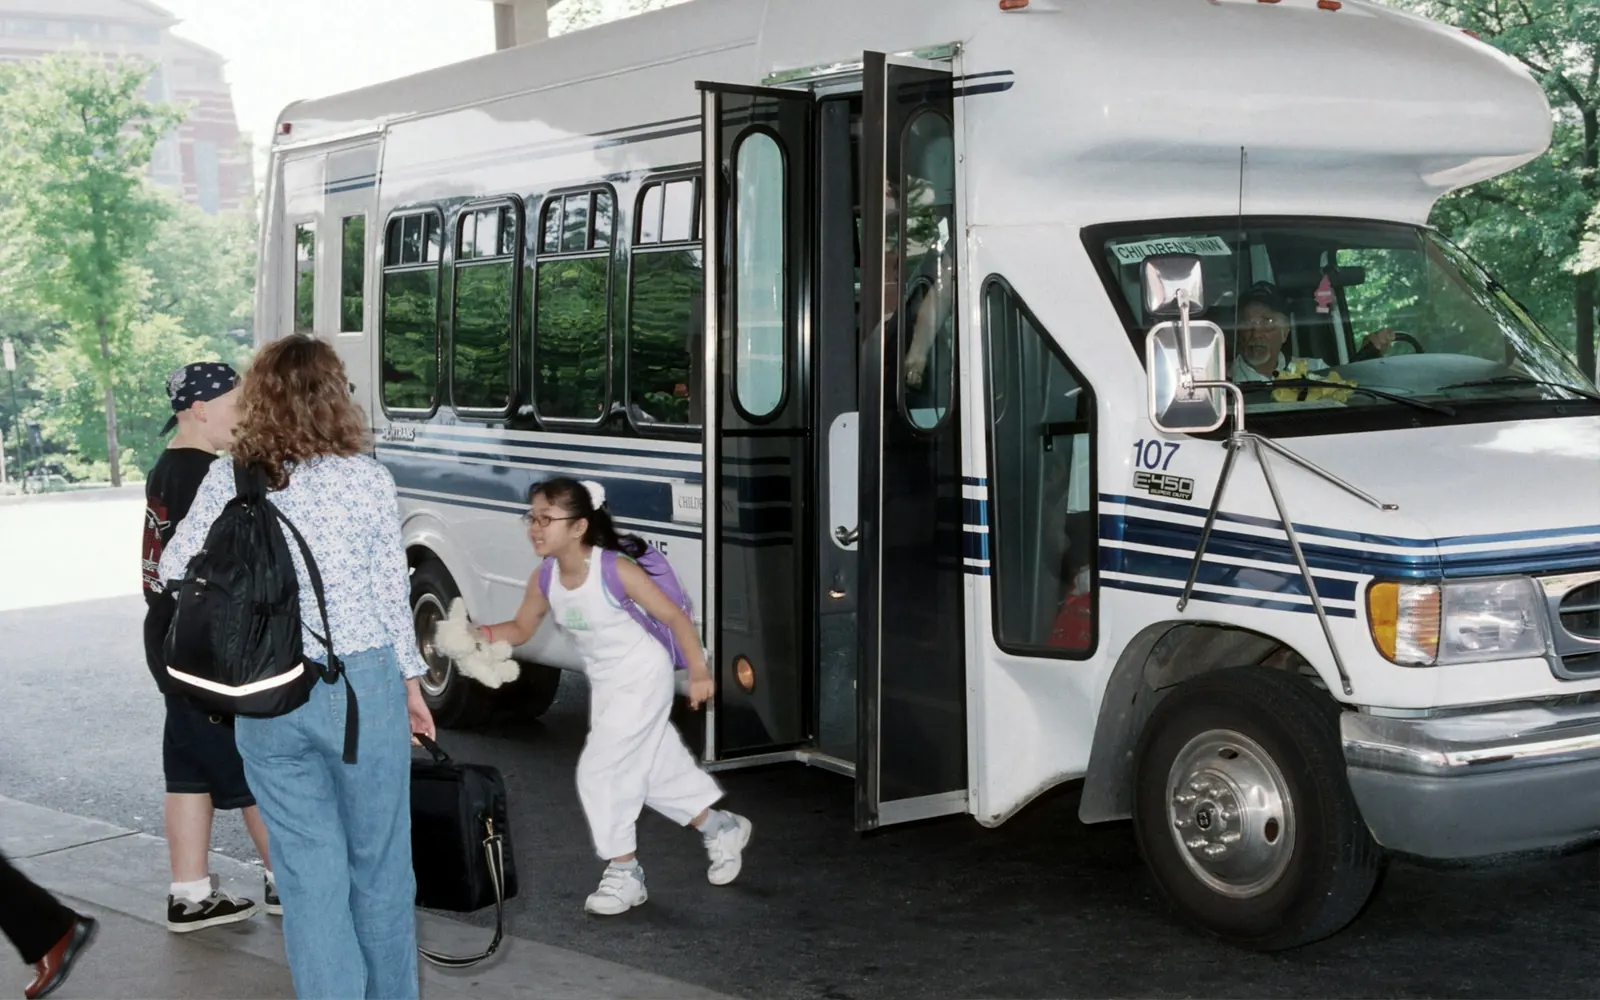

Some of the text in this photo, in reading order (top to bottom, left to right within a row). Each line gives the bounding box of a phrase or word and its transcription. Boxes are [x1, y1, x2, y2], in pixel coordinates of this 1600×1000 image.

[1117, 241, 1196, 259] CHILDREN'S
[1133, 438, 1181, 471] 107
[1172, 491, 1190, 499] DUTY
